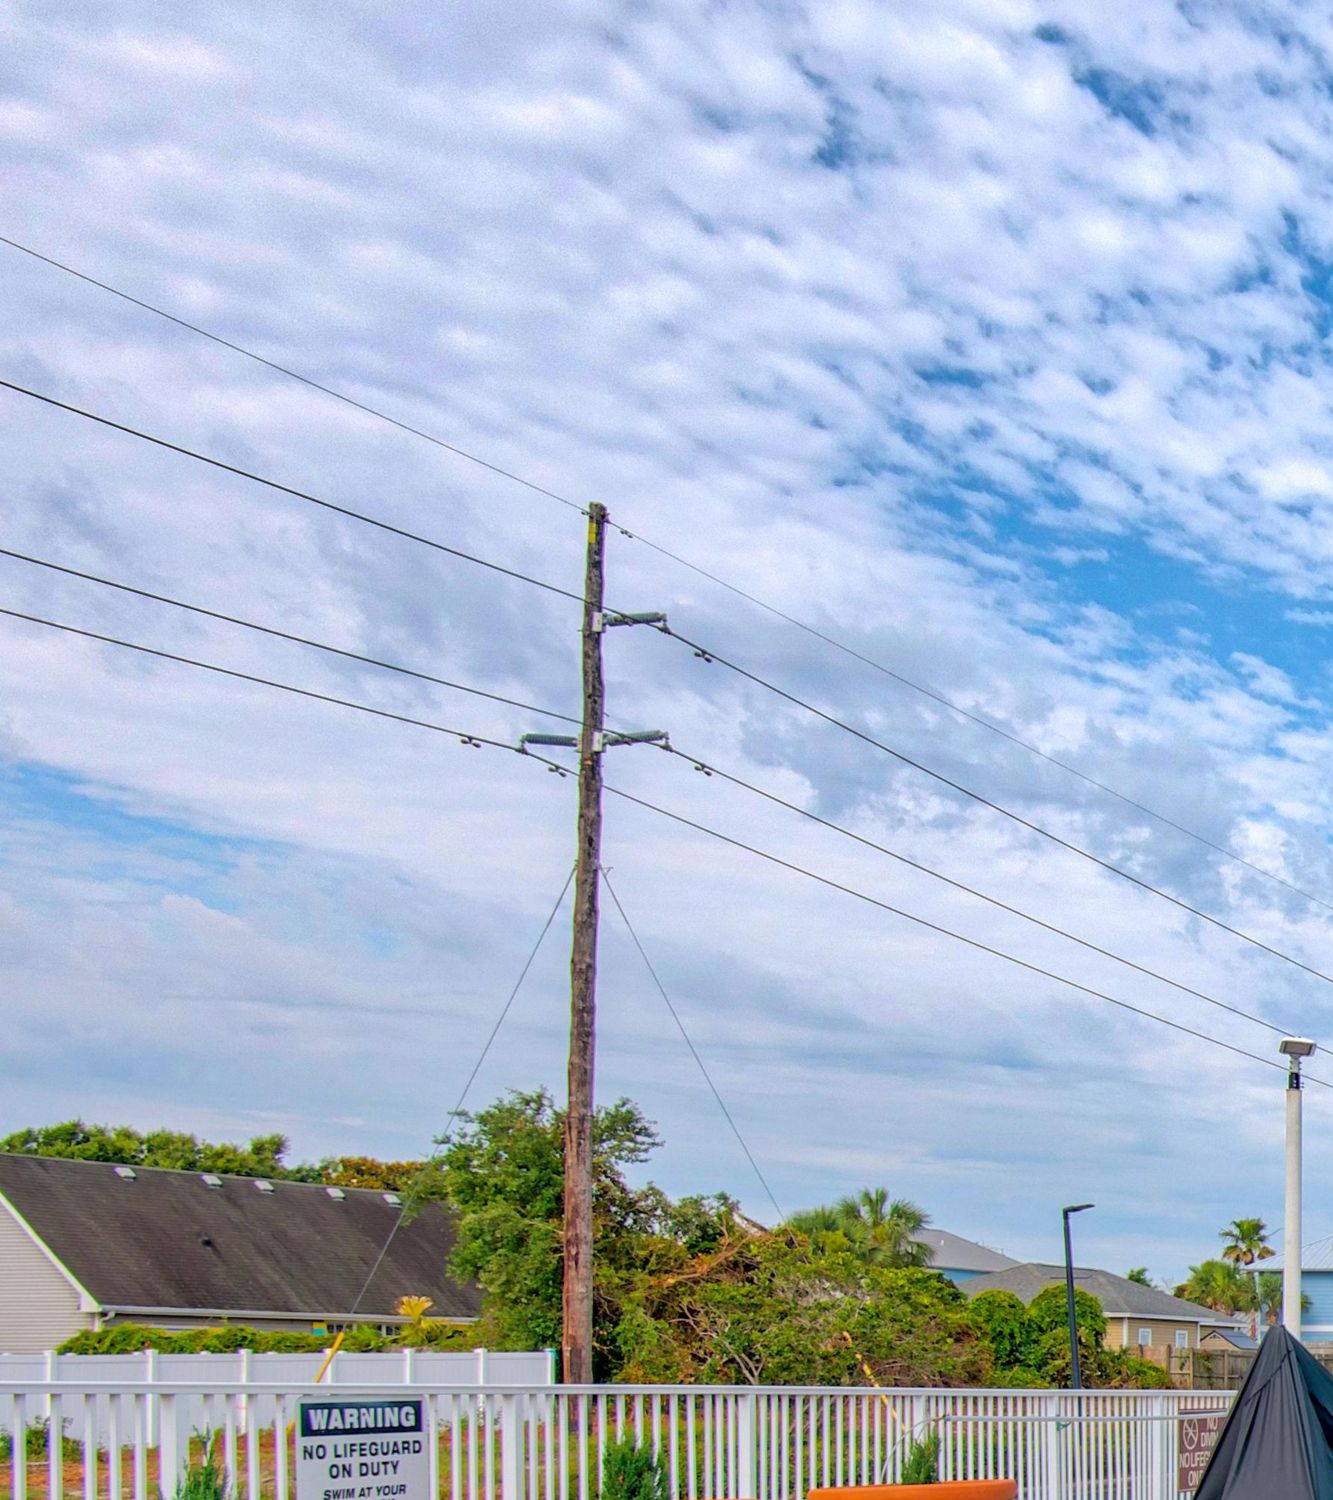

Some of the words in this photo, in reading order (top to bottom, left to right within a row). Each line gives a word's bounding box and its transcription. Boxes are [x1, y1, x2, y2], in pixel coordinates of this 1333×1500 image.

[308, 1405, 417, 1431] WARNING
[1206, 1417, 1218, 1431] NO
[303, 1444, 326, 1461] NO
[333, 1440, 423, 1459] LIFEGUARD
[328, 1463, 353, 1480] ON
[359, 1460, 400, 1477] DUTY
[323, 1487, 355, 1500] SWIM
[358, 1486, 373, 1498] AT
[376, 1484, 407, 1497] YOUR
